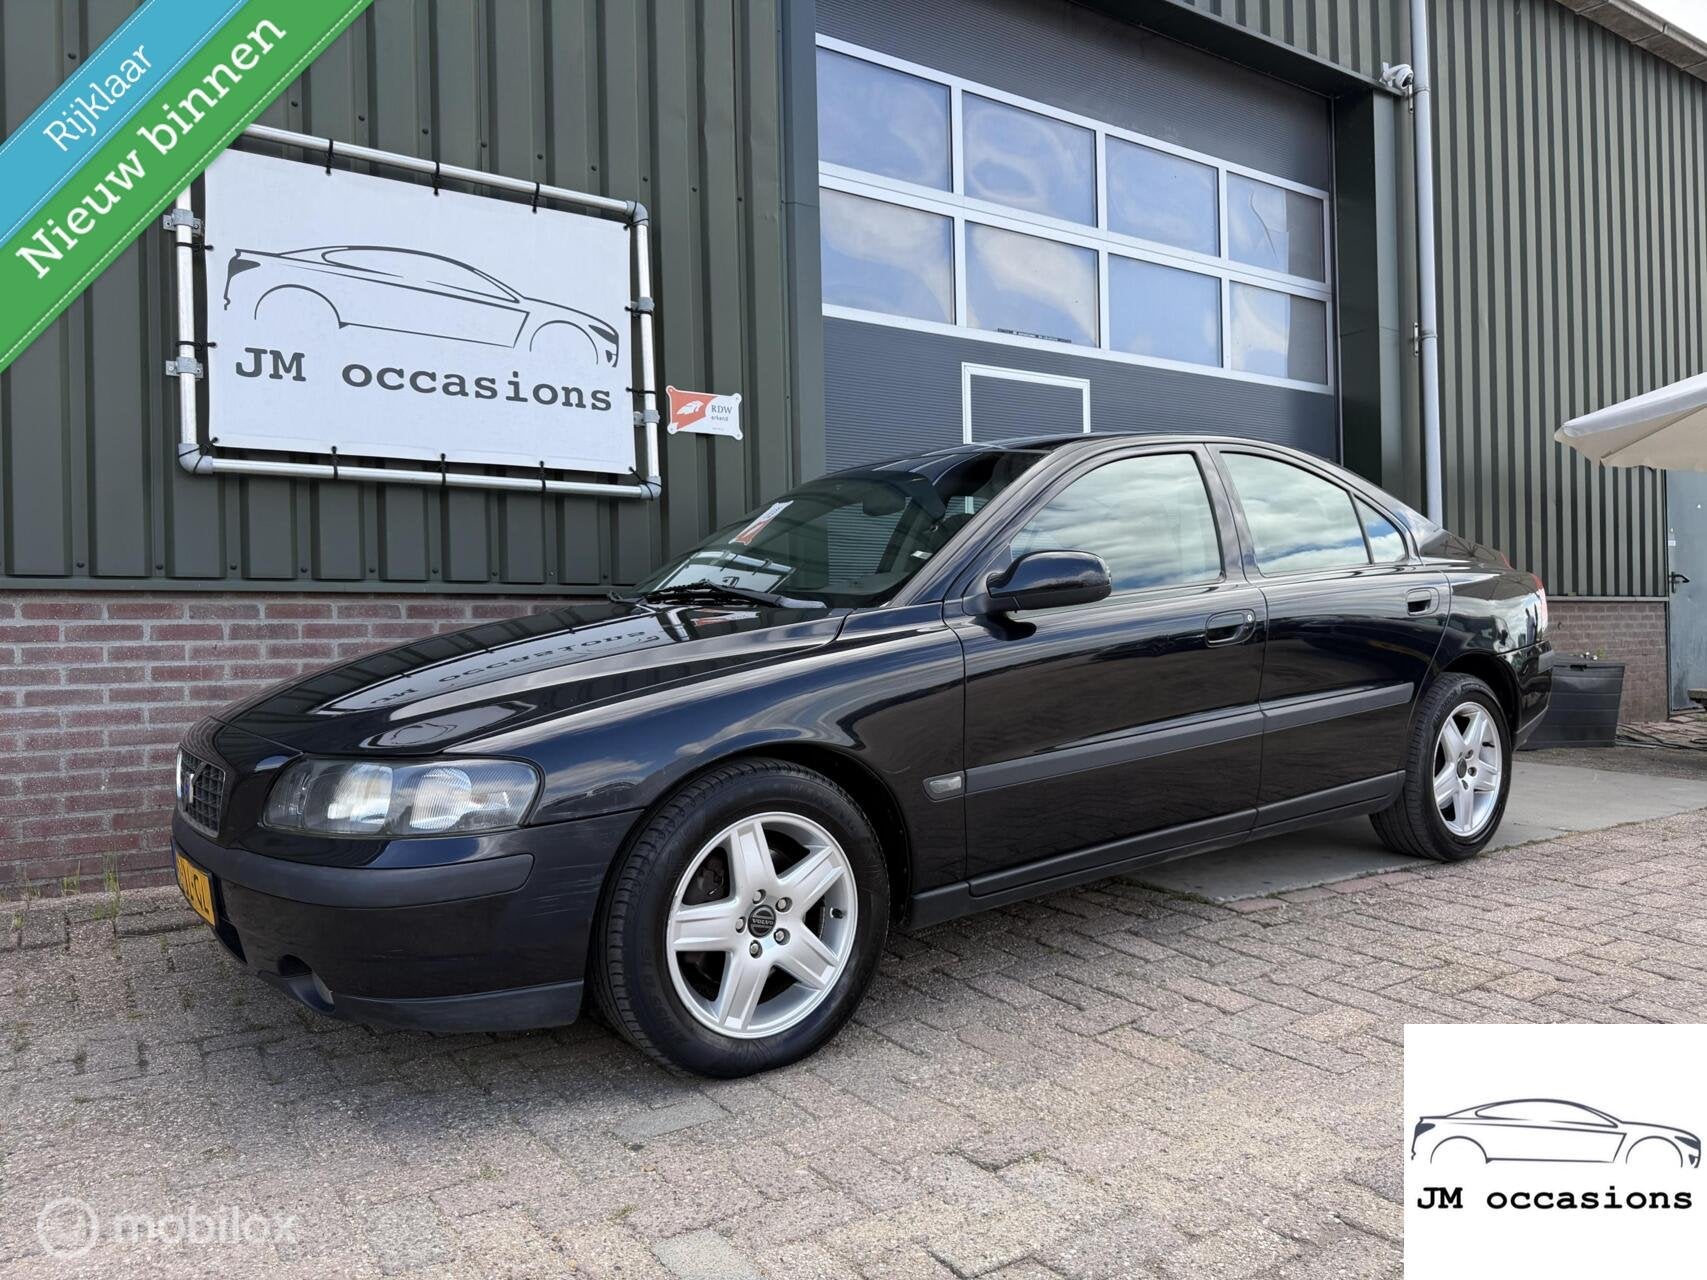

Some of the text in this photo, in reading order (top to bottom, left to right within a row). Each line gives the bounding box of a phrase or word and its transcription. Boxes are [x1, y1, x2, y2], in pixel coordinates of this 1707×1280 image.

[235, 347, 612, 411] JM occasions
[711, 404, 732, 414] RDW
